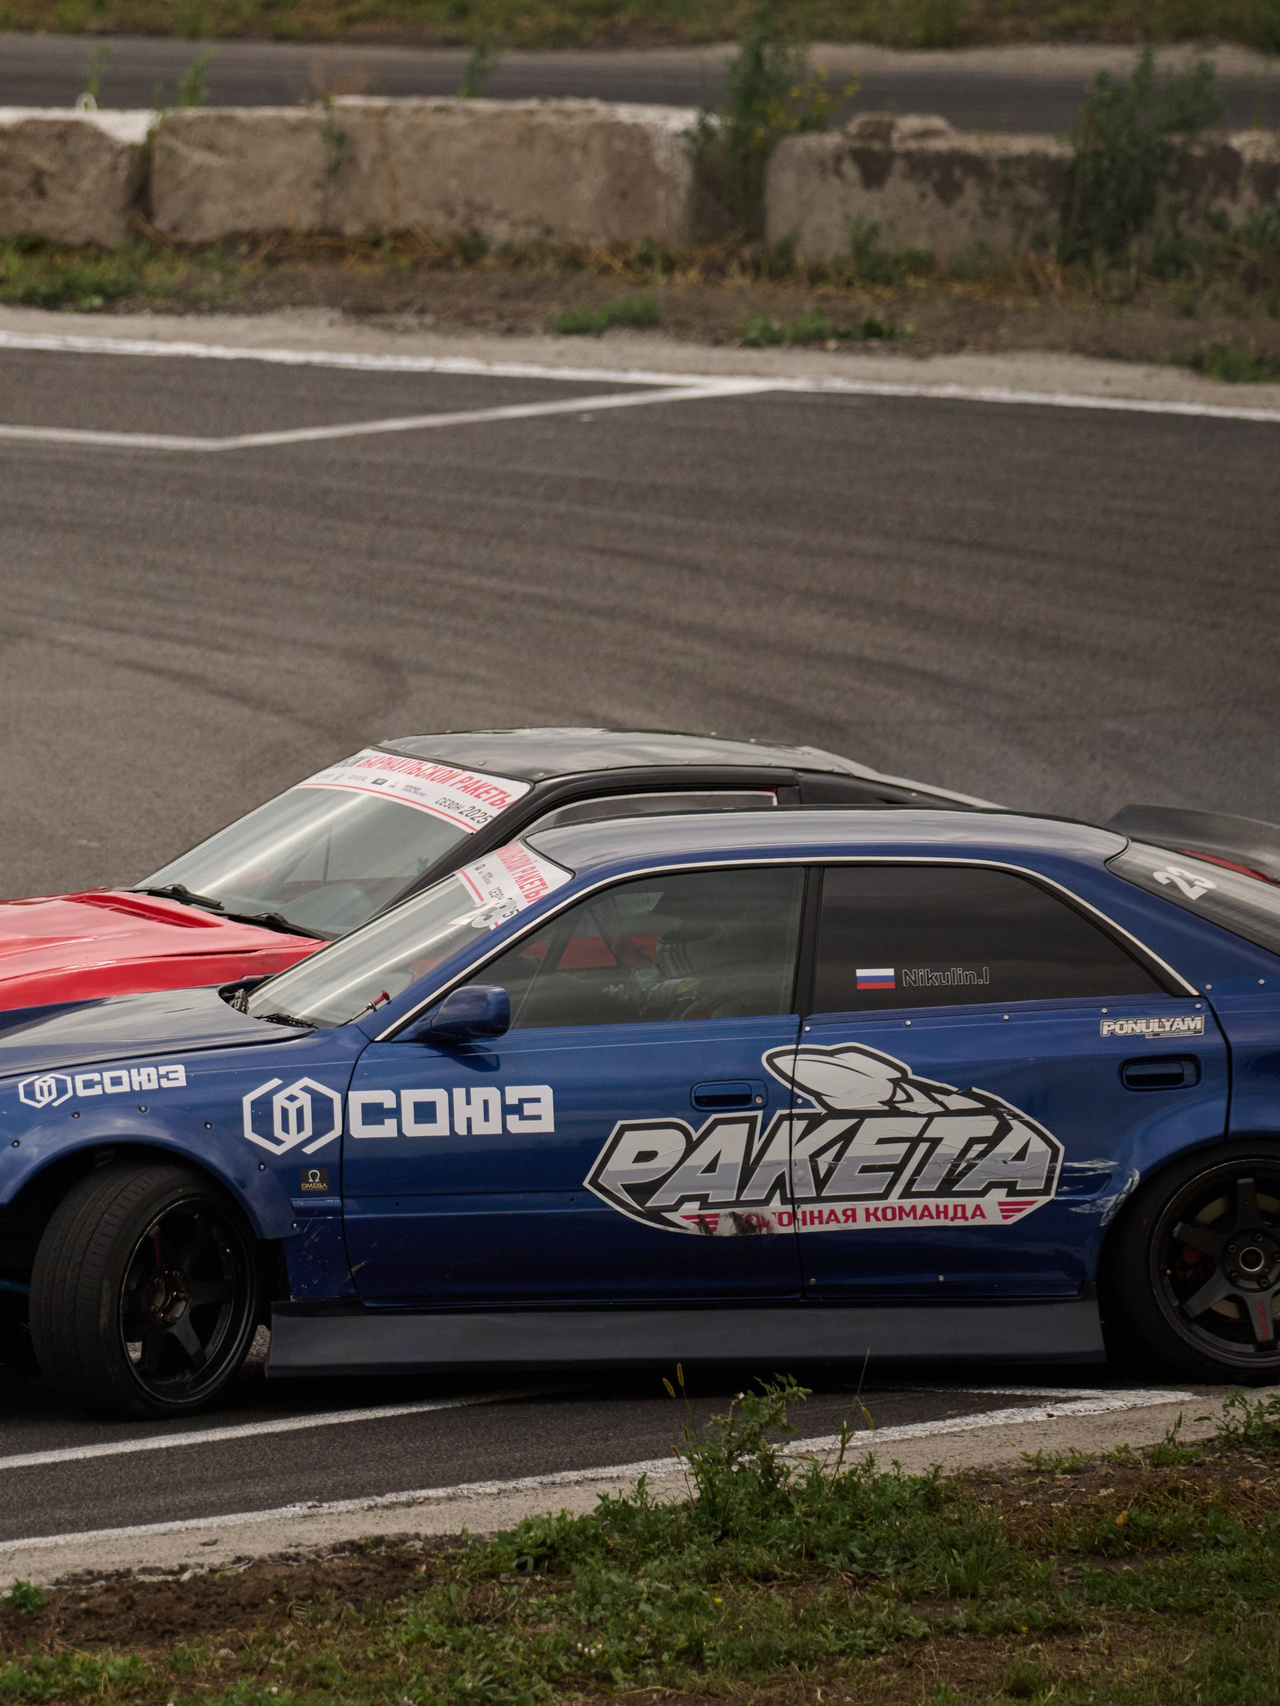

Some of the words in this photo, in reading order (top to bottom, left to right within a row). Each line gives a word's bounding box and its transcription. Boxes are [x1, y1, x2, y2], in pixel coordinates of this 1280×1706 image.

[449, 775, 517, 810] РАКЕТЫ
[459, 805, 494, 824] 2025
[1152, 866, 1217, 900] 23
[1102, 1016, 1202, 1035] PONULYAM
[75, 1064, 187, 1097] СОЮЗ
[348, 1084, 555, 1138] СОЮЗ
[597, 1113, 1054, 1208] РАКЕТА
[864, 1203, 987, 1223] КОМАНДА
